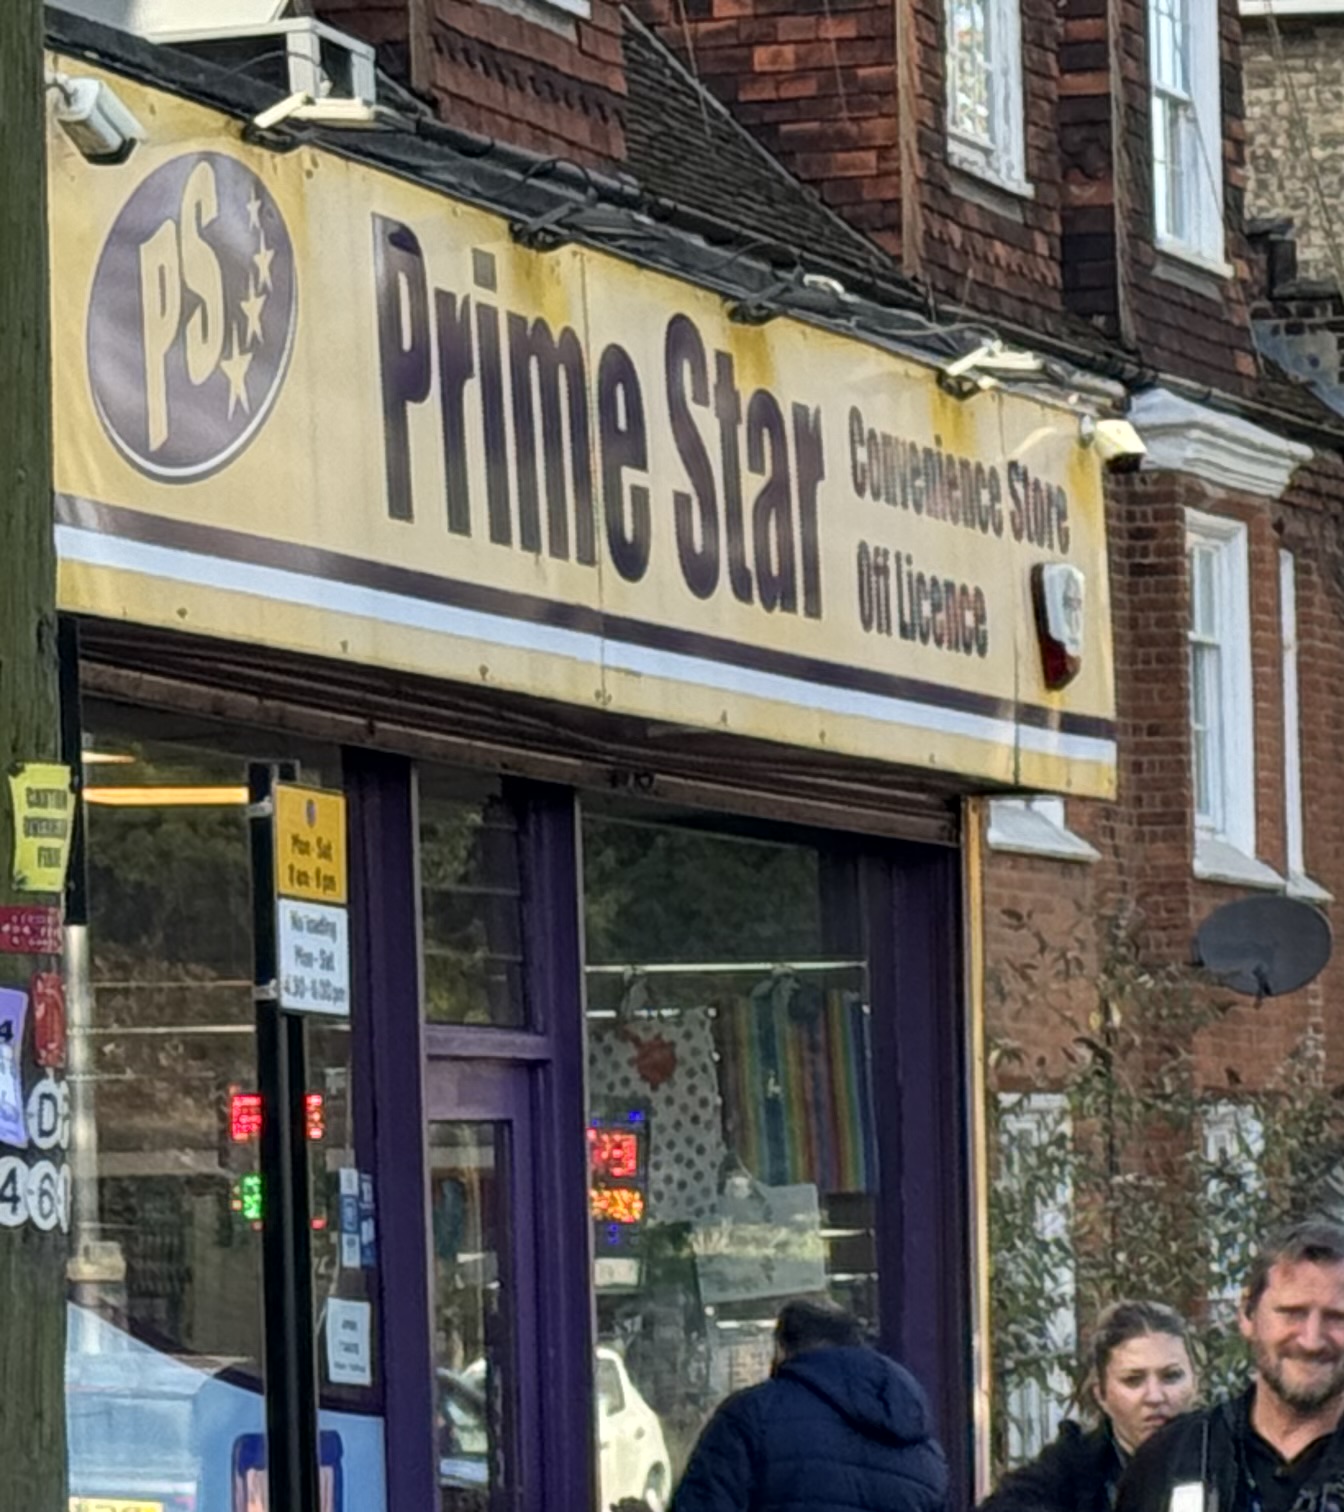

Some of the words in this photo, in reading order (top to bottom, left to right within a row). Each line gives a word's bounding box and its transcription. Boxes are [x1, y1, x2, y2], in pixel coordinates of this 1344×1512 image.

[140, 160, 224, 451] PS
[372, 212, 652, 583] Prime
[665, 312, 825, 620] Star
[849, 405, 1003, 538] Convenience
[1008, 459, 1070, 555] Store
[857, 539, 892, 637] Off
[895, 550, 988, 658] Licence
